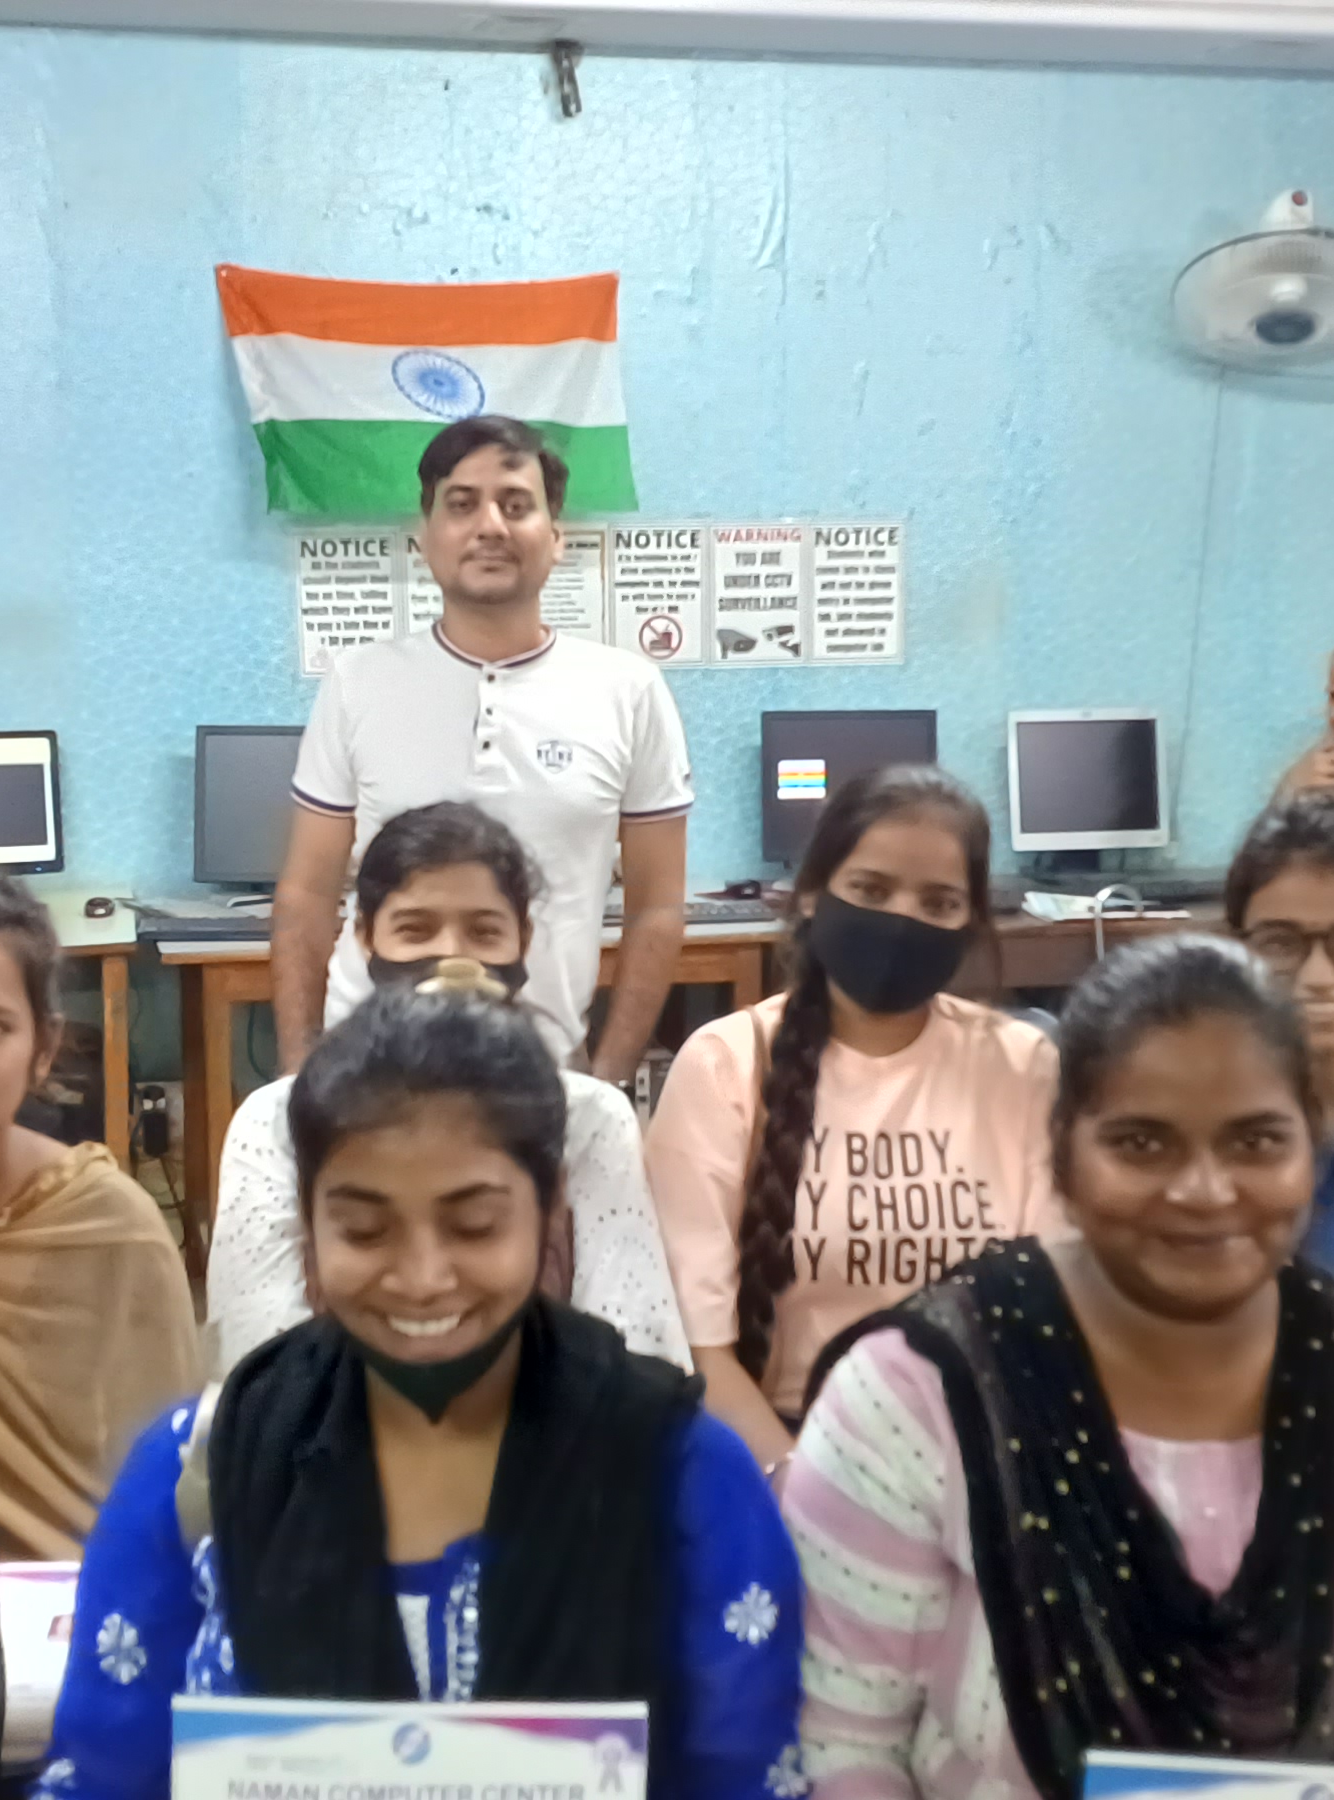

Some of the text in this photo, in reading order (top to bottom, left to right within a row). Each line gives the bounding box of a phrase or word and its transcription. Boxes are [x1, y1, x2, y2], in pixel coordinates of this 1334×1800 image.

[615, 530, 701, 549] NOTICE
[715, 528, 801, 542] WARNING
[815, 527, 899, 546] NOTICE
[300, 538, 389, 557] NOTICE
[846, 1130, 964, 1179] BODY.
[805, 1180, 828, 1231] Y
[804, 1236, 826, 1281] Y
[228, 1780, 584, 1800] NAMAN COMPUTER CENTER
